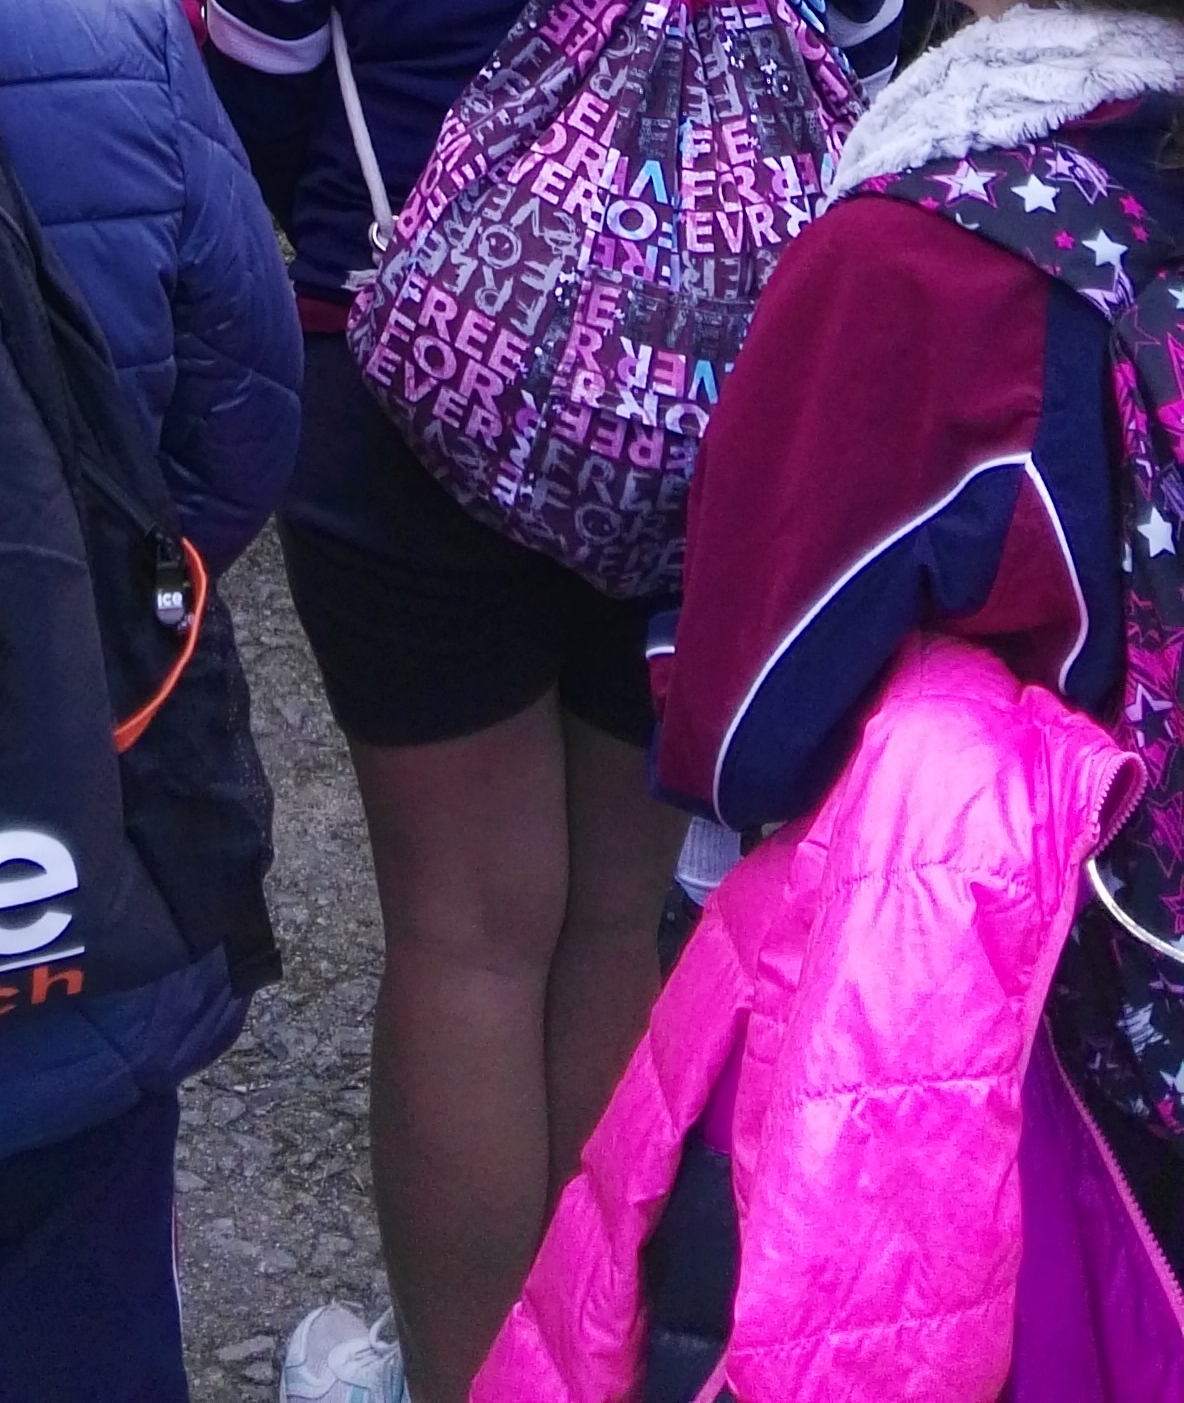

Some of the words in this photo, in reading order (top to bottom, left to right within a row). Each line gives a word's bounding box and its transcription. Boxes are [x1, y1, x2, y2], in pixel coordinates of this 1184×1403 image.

[381, 308, 505, 416] FOR
[395, 267, 531, 385] FREE
[366, 344, 504, 452] EVER
